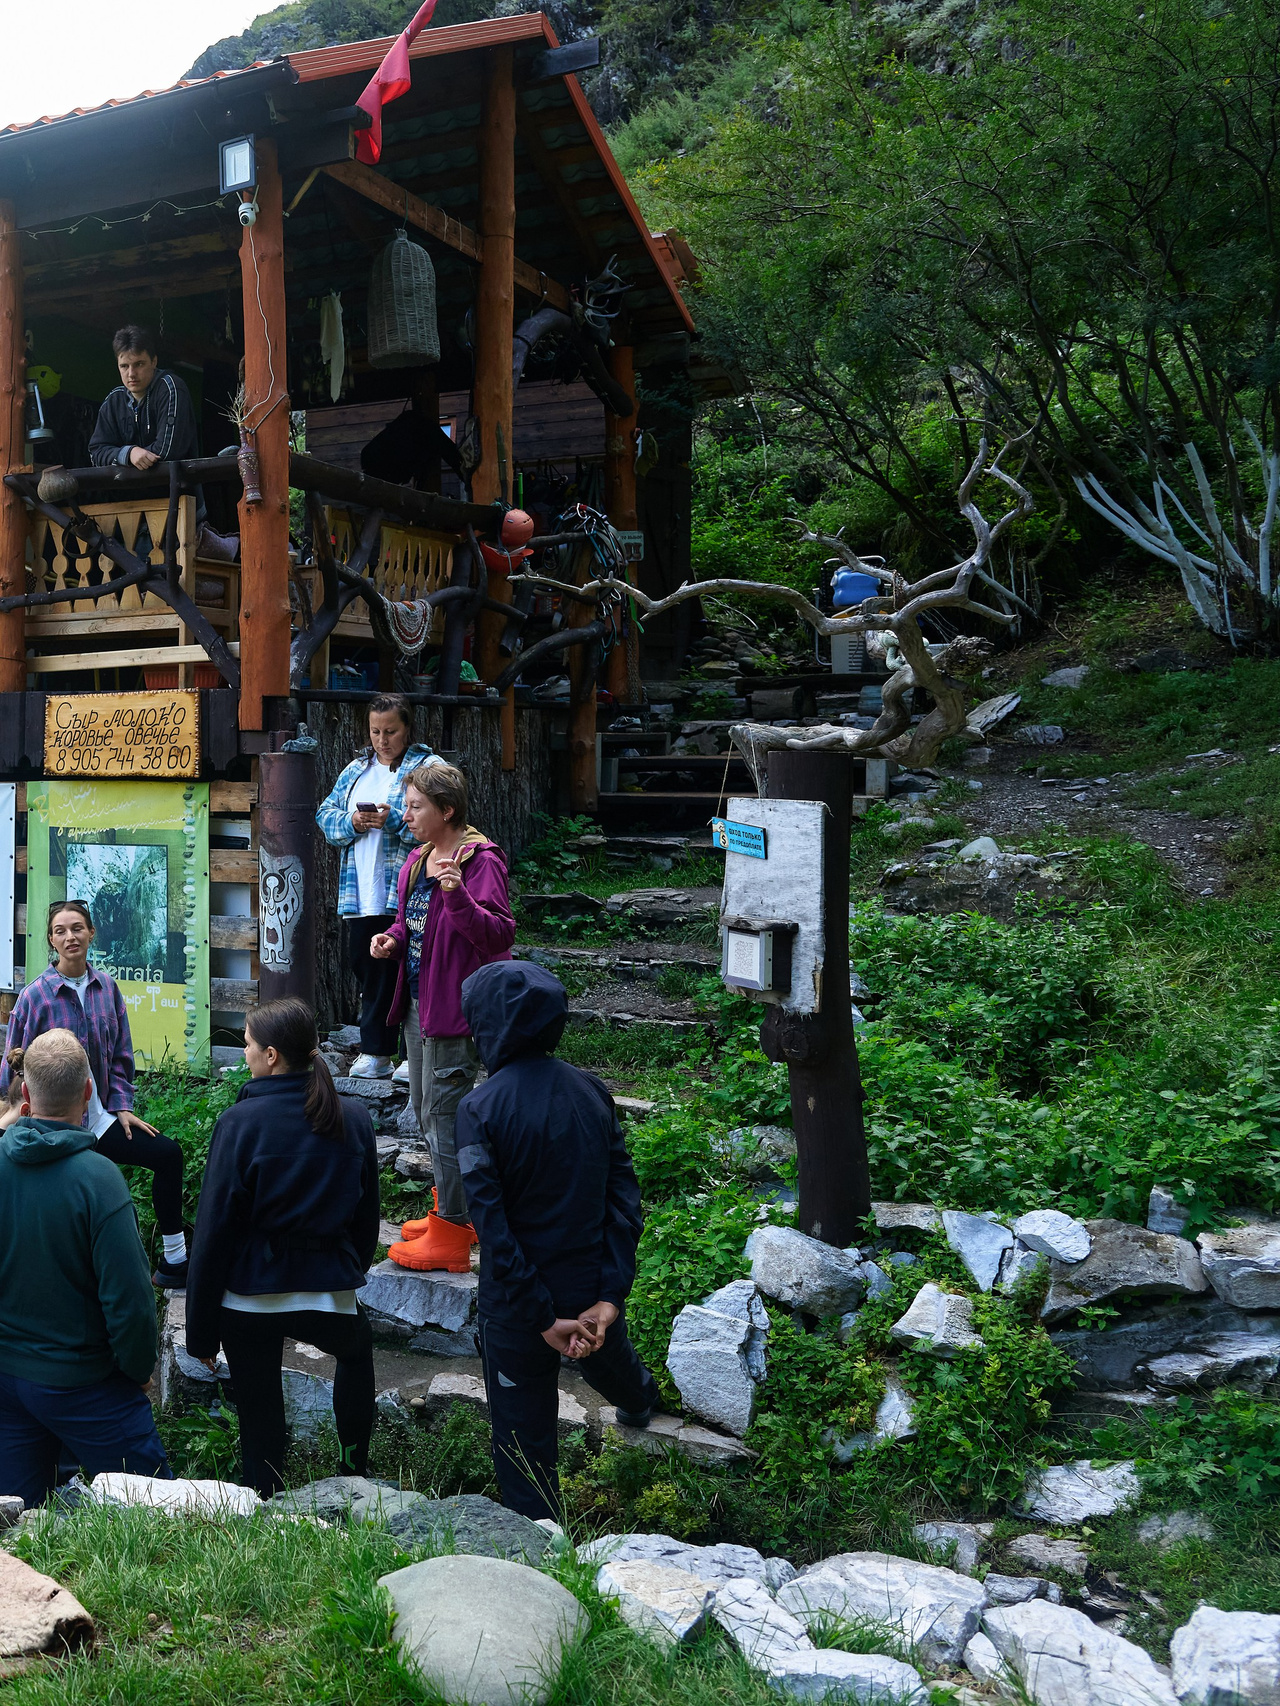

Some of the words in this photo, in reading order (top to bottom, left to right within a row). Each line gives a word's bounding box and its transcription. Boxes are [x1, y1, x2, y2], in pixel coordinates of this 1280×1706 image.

[56, 702, 98, 729] Сыр
[104, 702, 186, 727] молоко
[49, 729, 113, 748] коровье
[125, 726, 180, 745] овечье
[56, 749, 67, 771] 8
[71, 748, 103, 771] 905
[106, 748, 134, 770] 744
[141, 747, 163, 770] 38
[168, 745, 191, 769] 60
